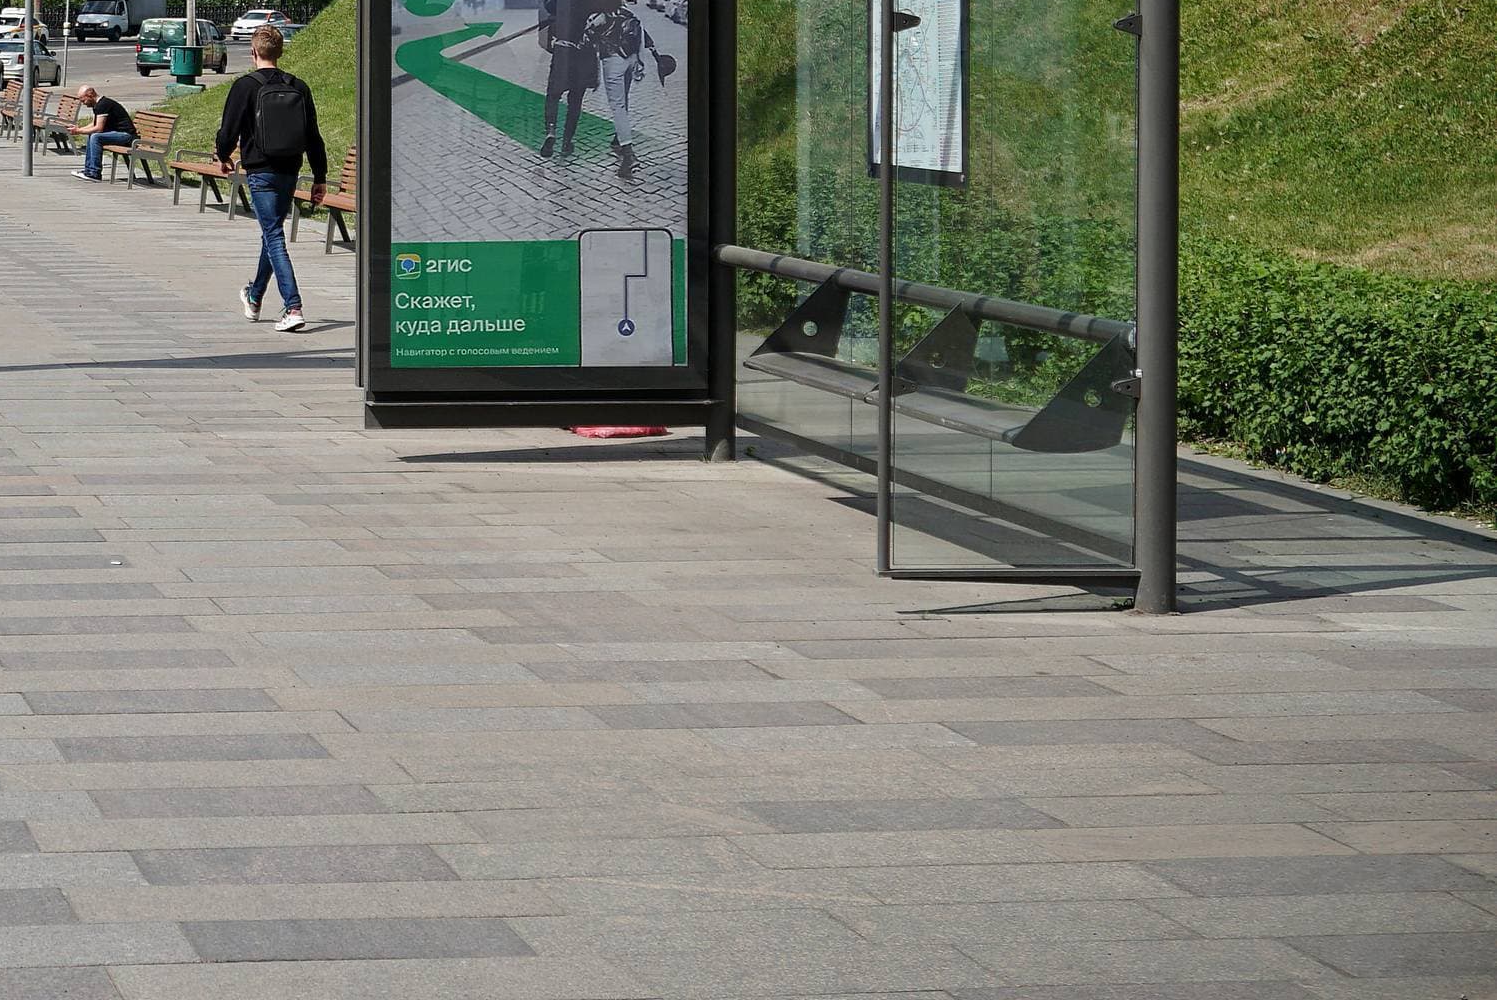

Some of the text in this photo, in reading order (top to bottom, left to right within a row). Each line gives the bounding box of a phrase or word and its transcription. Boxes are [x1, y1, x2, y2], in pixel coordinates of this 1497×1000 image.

[425, 259, 473, 273] 2ГИС
[395, 292, 476, 311] Скажет,
[395, 318, 526, 336] куда дальше
[396, 348, 447, 357] Навигатор
[456, 348, 510, 356] голосовым
[511, 346, 560, 355] ведением
